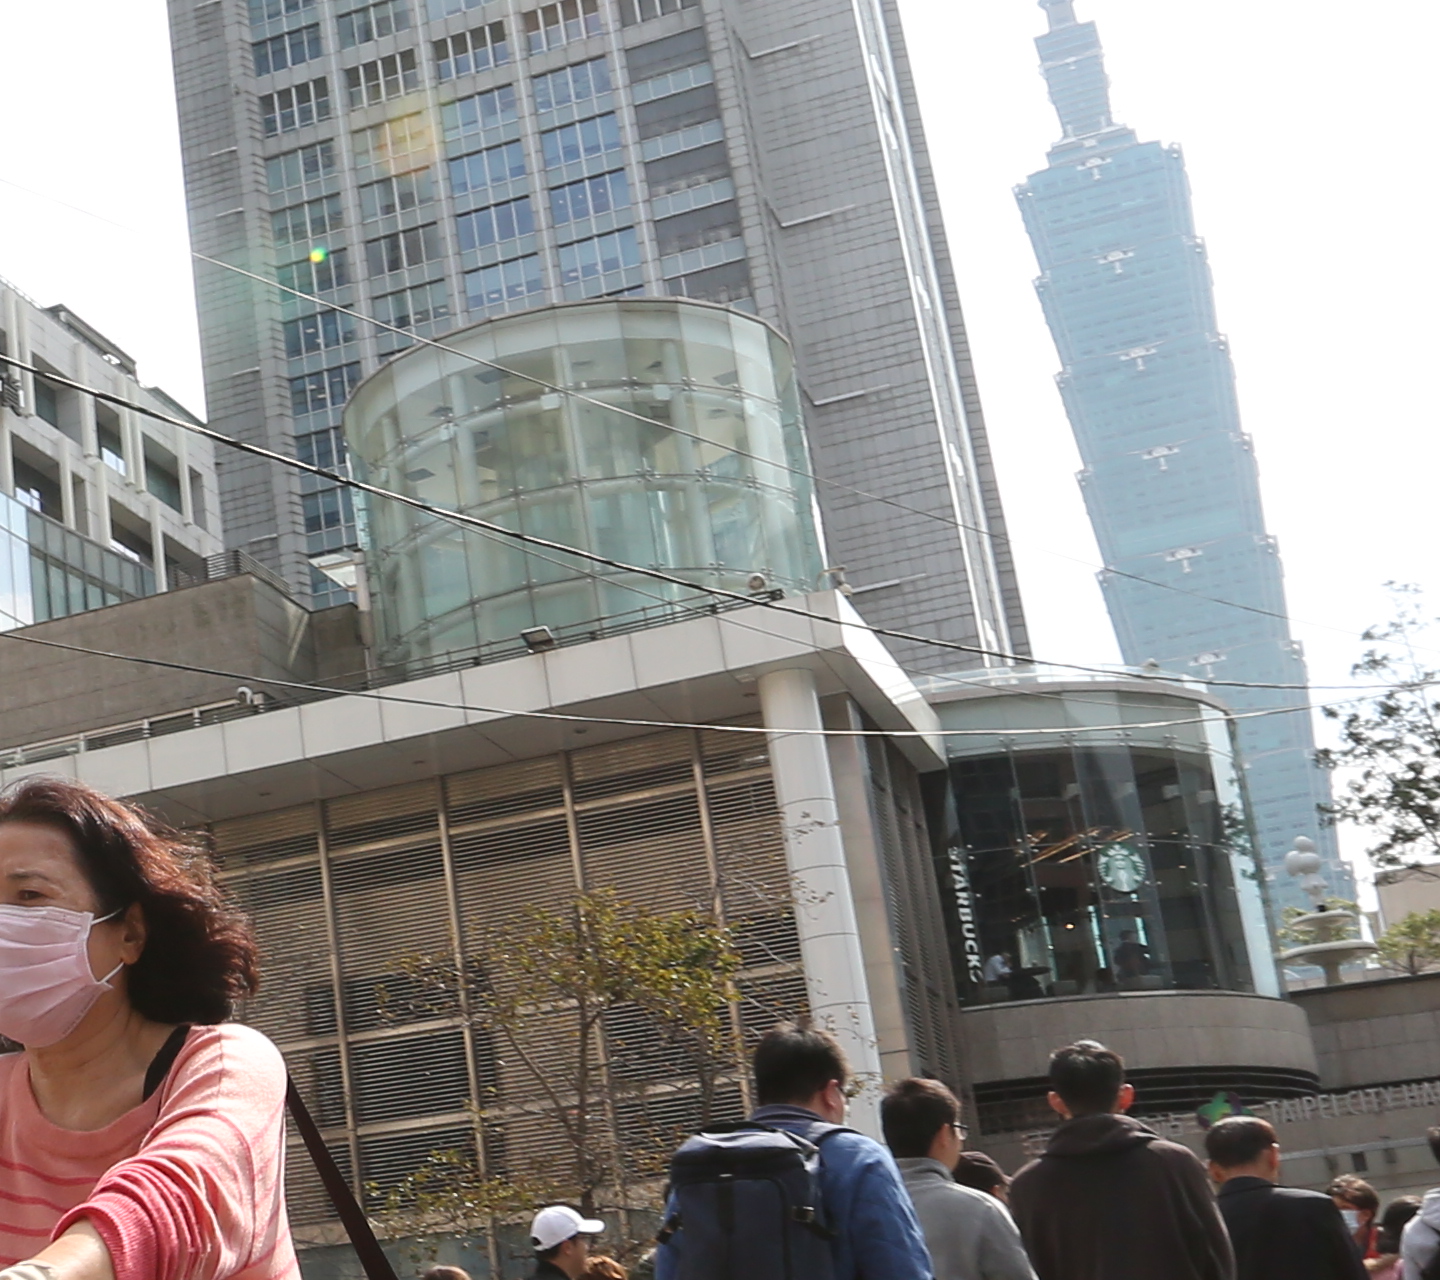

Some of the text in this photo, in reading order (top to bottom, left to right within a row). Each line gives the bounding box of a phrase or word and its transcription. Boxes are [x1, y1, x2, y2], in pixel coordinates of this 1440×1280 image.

[948, 846, 983, 983] STARBUCKS
[1266, 1093, 1338, 1123] TAIPEI
[1346, 1086, 1395, 1117] CITY
